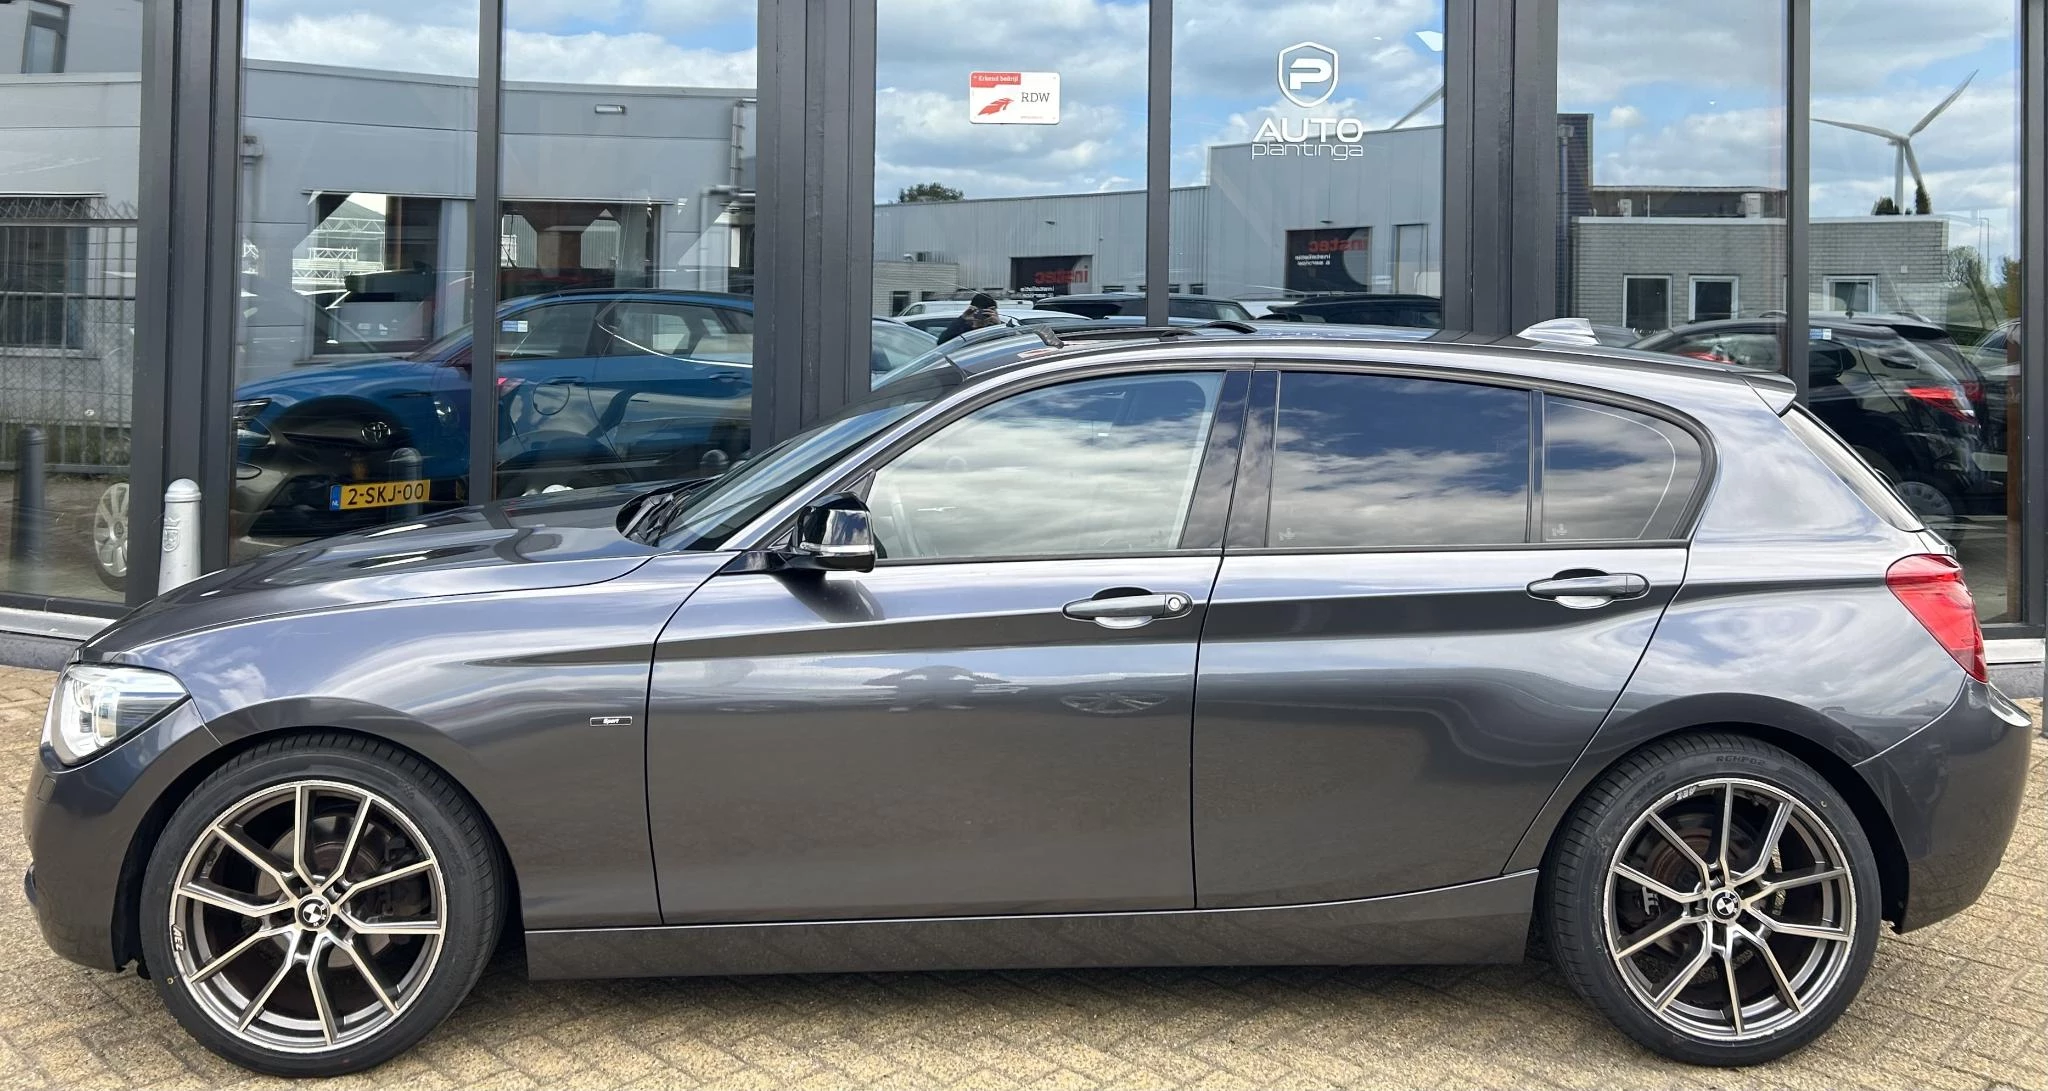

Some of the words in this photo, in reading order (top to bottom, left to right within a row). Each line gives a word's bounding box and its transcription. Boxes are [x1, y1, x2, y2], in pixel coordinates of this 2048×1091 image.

[1288, 58, 1332, 90] P
[1021, 92, 1050, 103] RDW
[1252, 117, 1364, 143] AUTO
[1251, 140, 1364, 160] plantinga
[347, 483, 424, 505] 2-SKJ-00
[172, 926, 184, 951] AEZ
